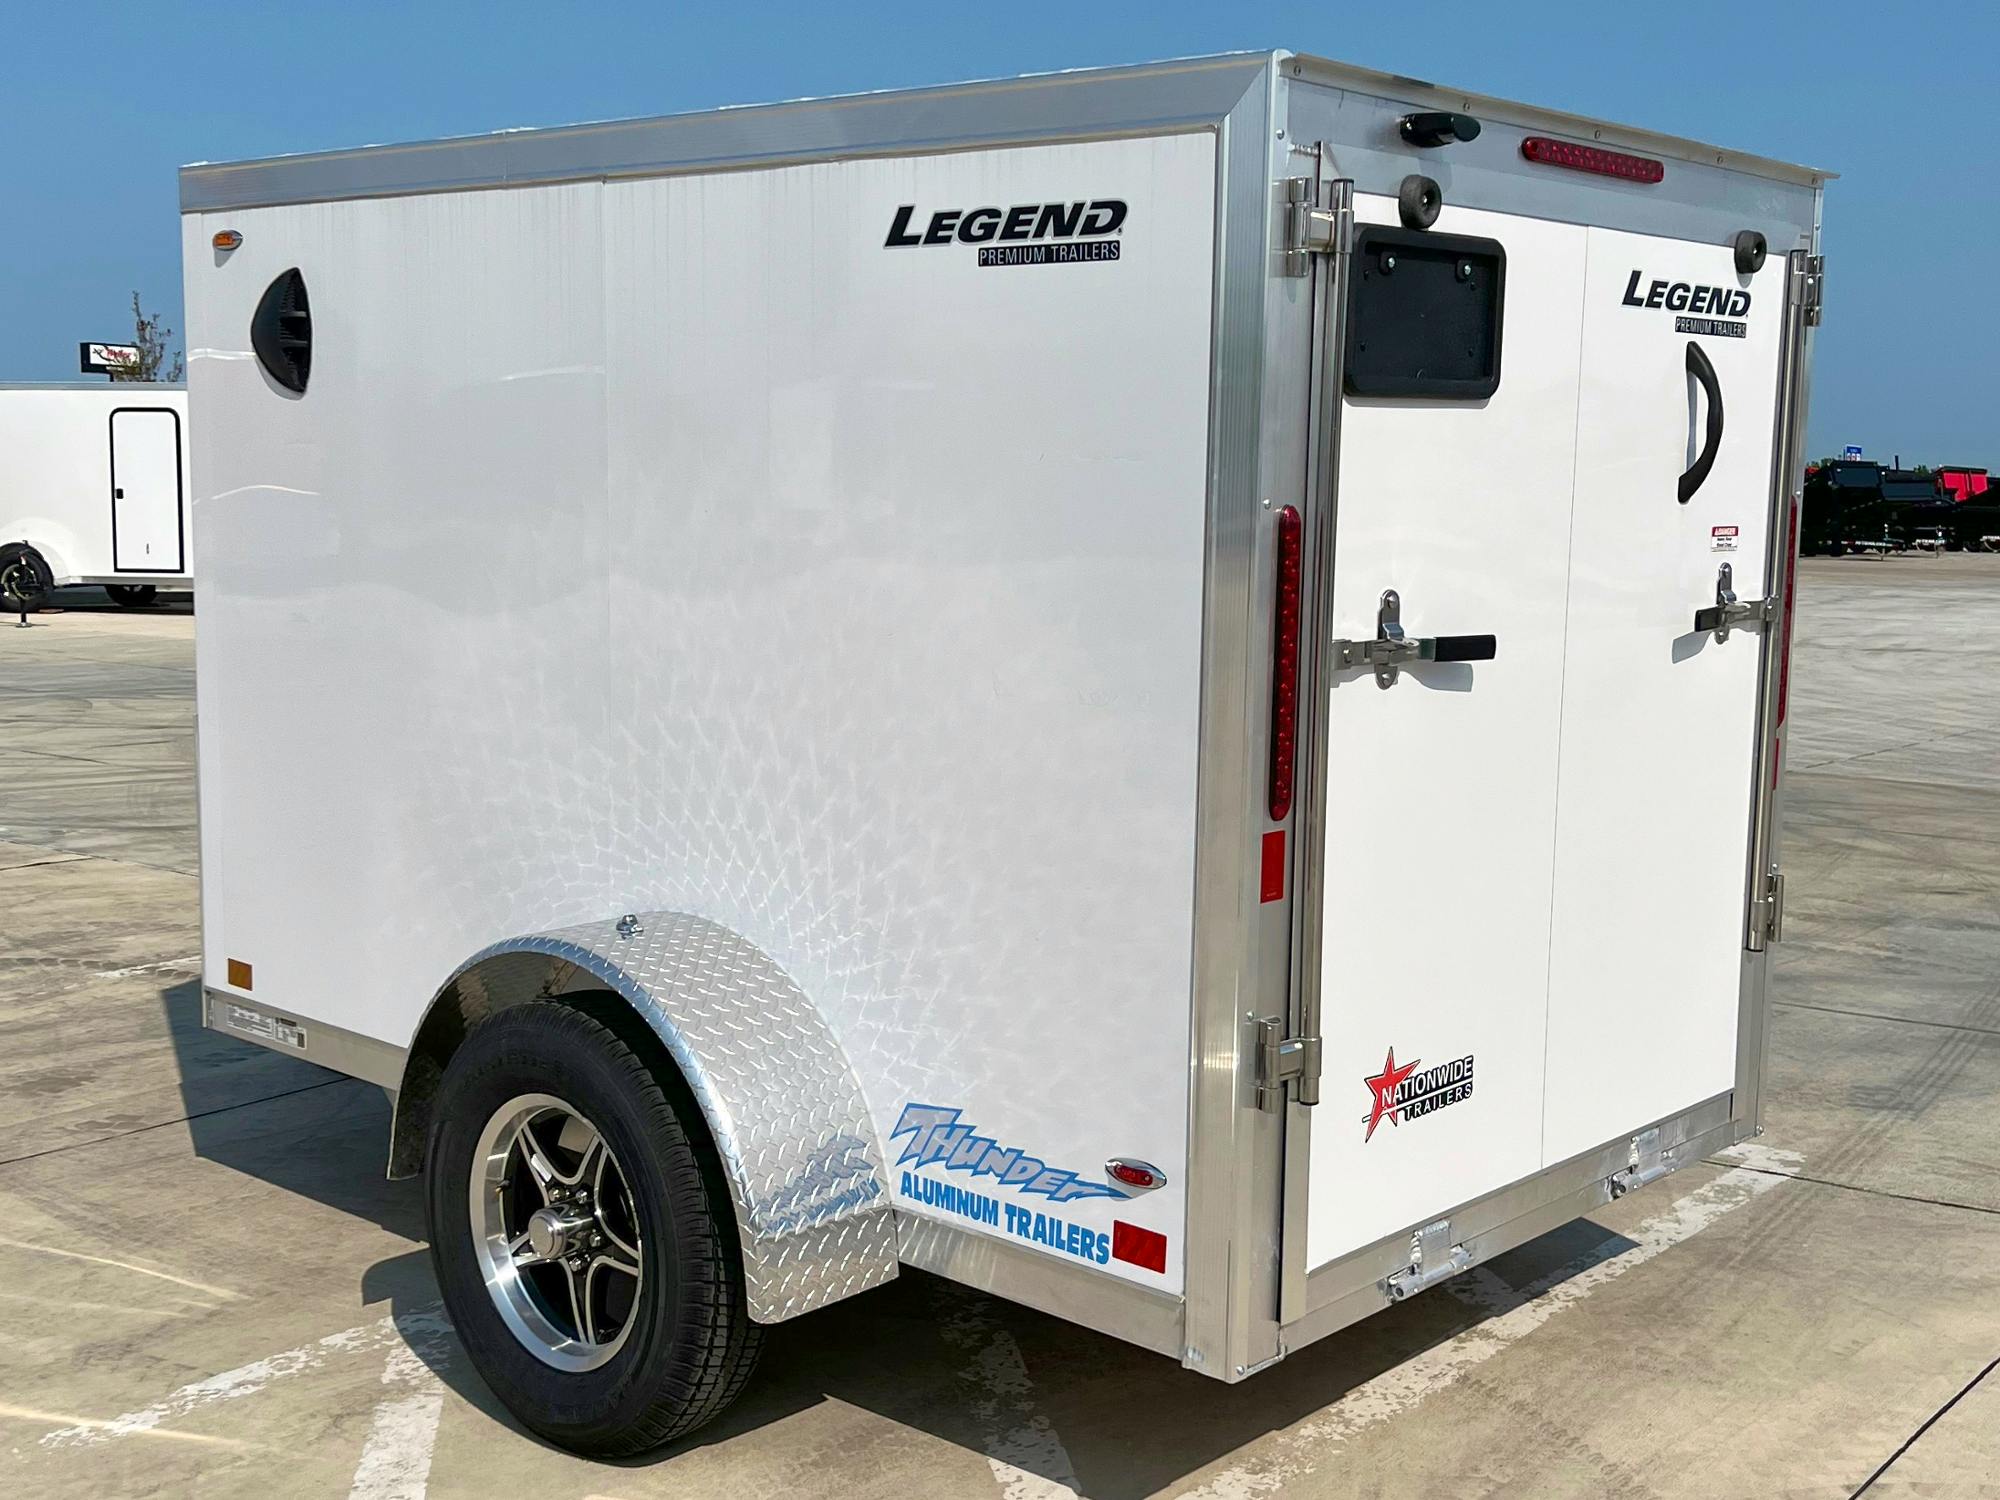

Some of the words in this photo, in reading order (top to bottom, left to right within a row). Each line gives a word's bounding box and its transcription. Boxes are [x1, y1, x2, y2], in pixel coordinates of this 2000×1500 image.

[884, 199, 1128, 247] LEGEND
[979, 245, 1046, 266] PREMIUM
[1050, 242, 1119, 262] TRAILERS
[1621, 269, 1752, 317] LEGEND
[1675, 317, 1712, 334] PREMIUM
[1713, 321, 1747, 338] TRAILERS
[1381, 1055, 1474, 1108] NATIONWIDE
[1404, 1083, 1473, 1121] TRAILERS
[889, 1102, 1132, 1202] THUNDER
[900, 1171, 999, 1227] ALUMINUM
[1004, 1202, 1110, 1265] TRAILERS
